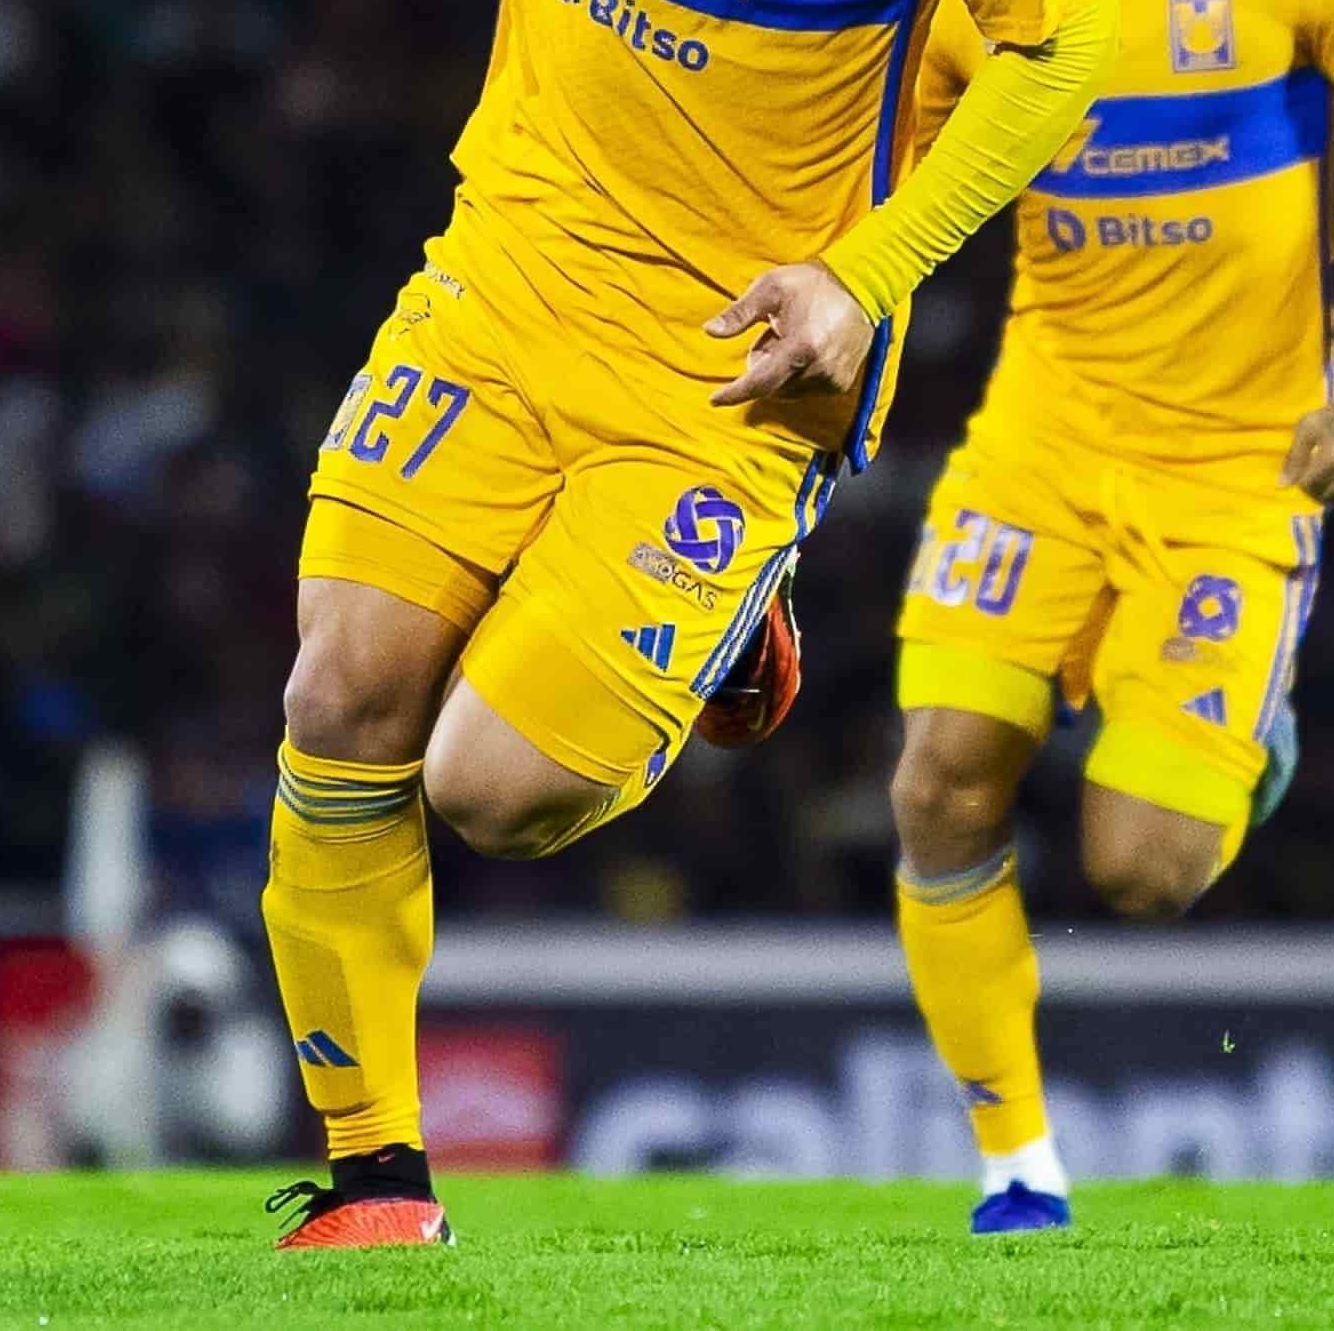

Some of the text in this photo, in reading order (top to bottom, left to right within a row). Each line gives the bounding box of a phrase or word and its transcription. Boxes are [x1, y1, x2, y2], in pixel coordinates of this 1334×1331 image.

[1083, 136, 1230, 176] CEMEX
[1097, 213, 1212, 247] Bitso
[349, 364, 471, 479] 27
[931, 508, 1035, 617] 20
